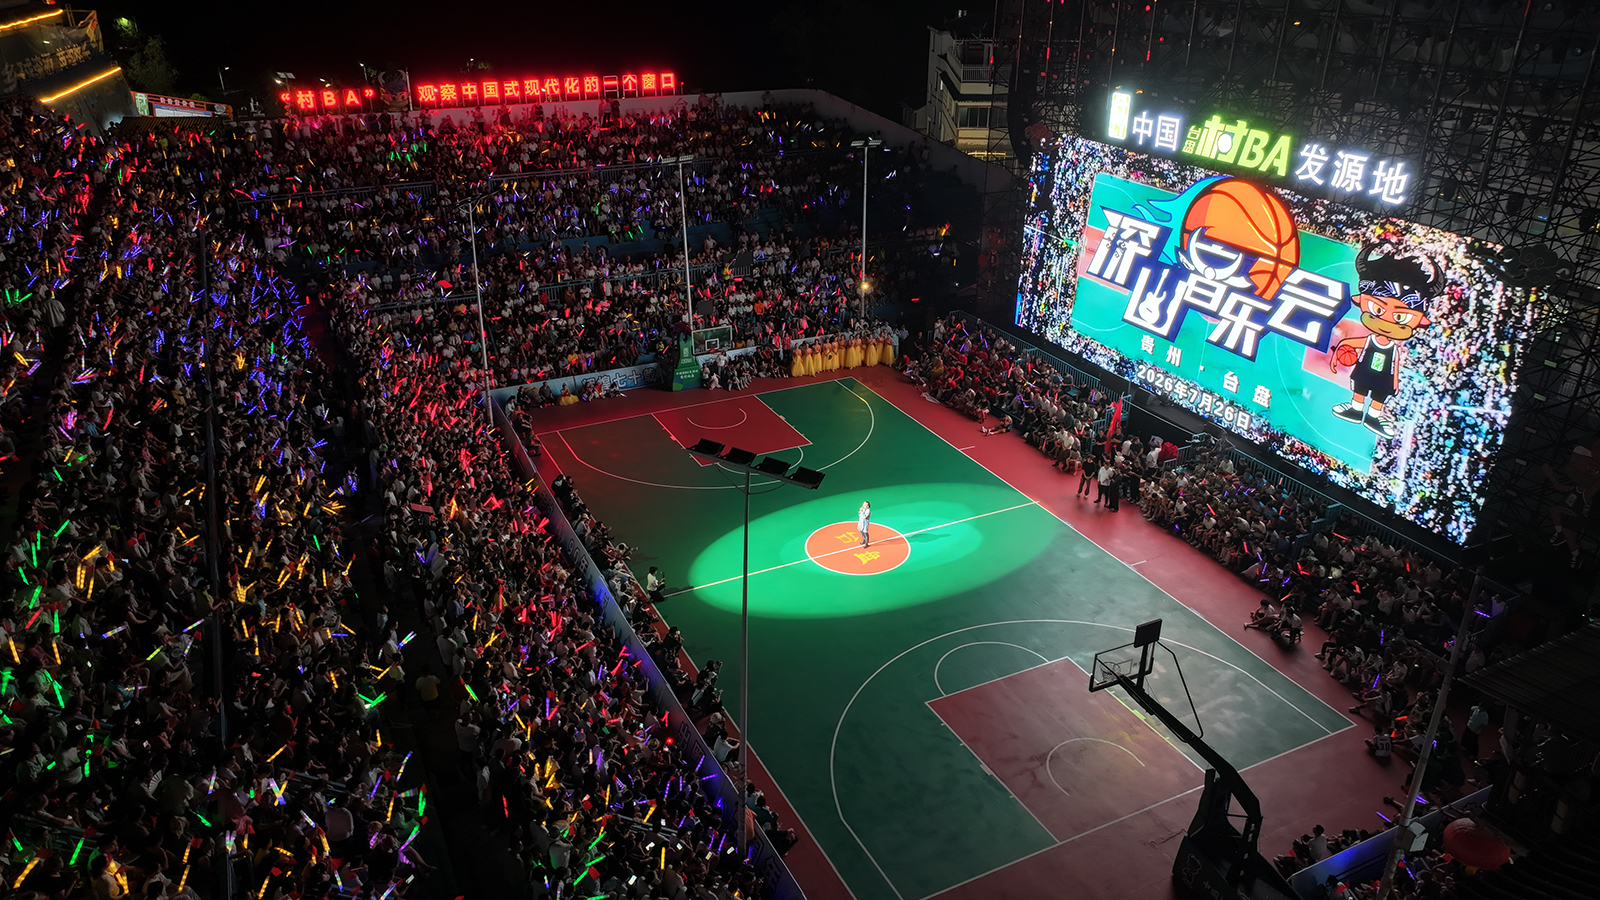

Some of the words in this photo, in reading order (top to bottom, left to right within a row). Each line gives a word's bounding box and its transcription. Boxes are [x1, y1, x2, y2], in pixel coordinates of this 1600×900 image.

[418, 71, 676, 102] 观察中国式现代化的一个窗口
[1195, 115, 1291, 177] 村BA
[1295, 143, 1409, 205] 发源地
[1137, 364, 1250, 430] 2026年7月26日
